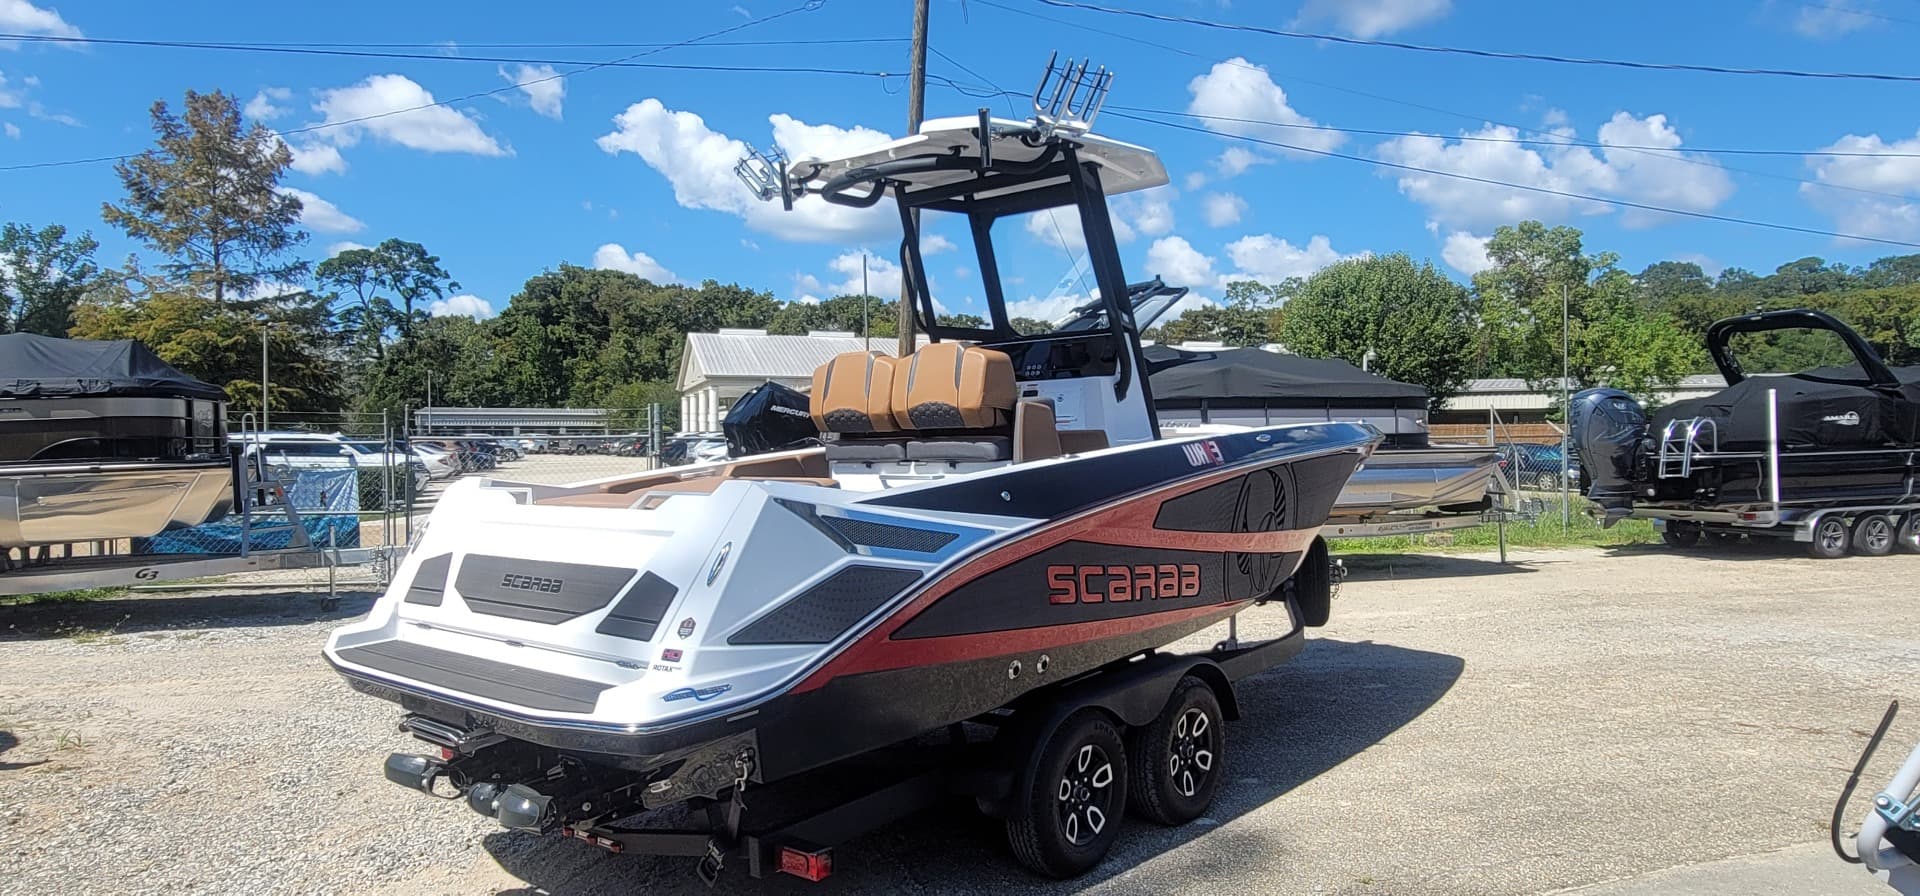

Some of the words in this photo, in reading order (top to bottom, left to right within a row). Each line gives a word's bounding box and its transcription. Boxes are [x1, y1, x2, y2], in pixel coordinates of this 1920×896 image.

[135, 567, 160, 581] G3
[501, 574, 563, 594] SCARAB
[1047, 564, 1201, 604] SCARAB
